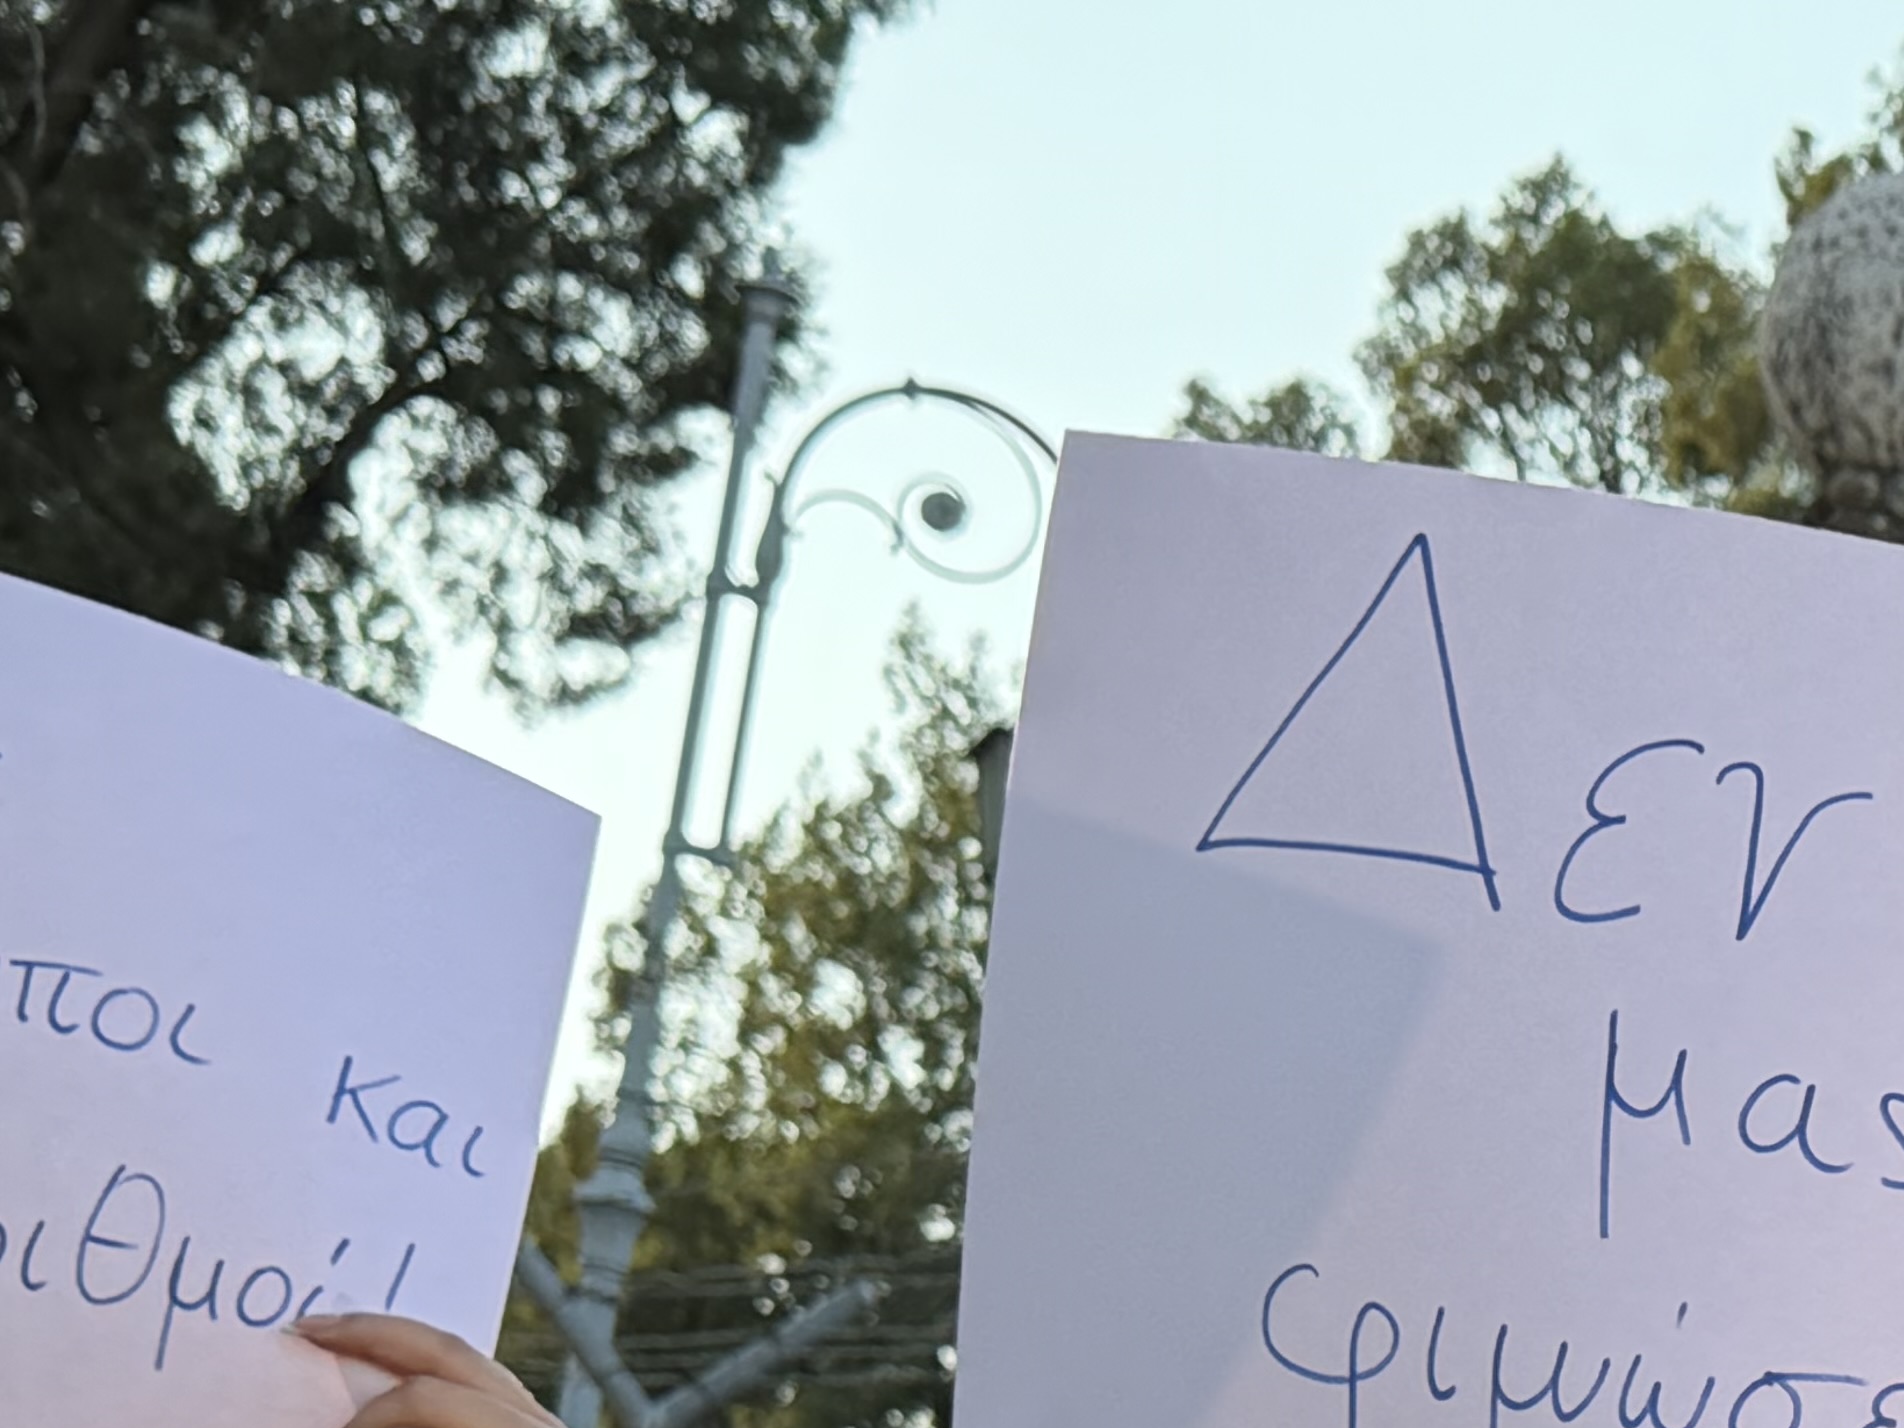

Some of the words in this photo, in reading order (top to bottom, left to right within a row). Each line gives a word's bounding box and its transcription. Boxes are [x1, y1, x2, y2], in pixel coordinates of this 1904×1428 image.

[1196, 533, 1873, 942] Δεν
[325, 1054, 486, 1179] και
[0, 1163, 416, 1371] ιθμοί!
